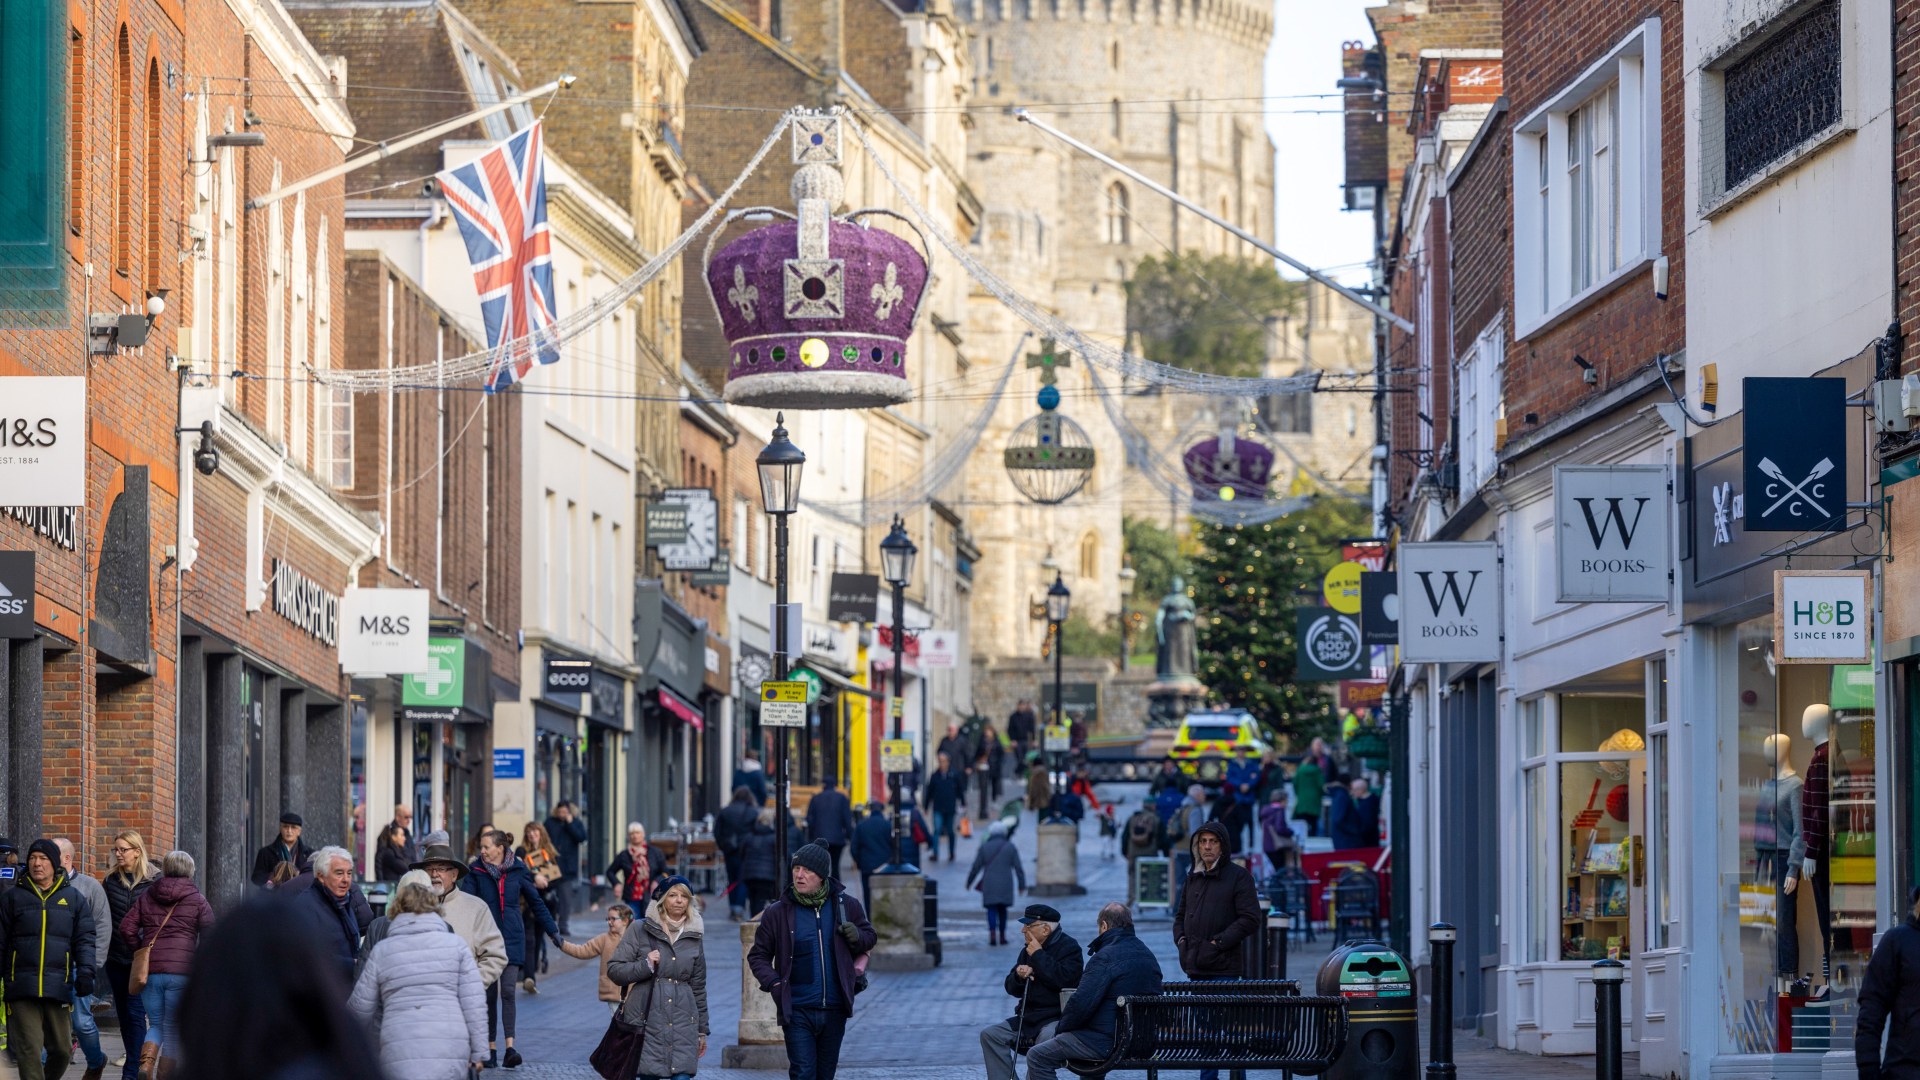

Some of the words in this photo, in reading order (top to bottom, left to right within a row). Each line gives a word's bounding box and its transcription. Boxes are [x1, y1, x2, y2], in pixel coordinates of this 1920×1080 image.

[0, 417, 57, 447] &S
[1573, 497, 1651, 551] W
[1581, 559, 1646, 573] BOOKS
[1413, 570, 1483, 618] W
[1793, 600, 1855, 626] H&B
[359, 615, 410, 635] M&S
[1421, 624, 1479, 638] BOOKS
[1323, 631, 1344, 640] THE
[1793, 632, 1827, 640] SINCE
[1831, 631, 1856, 640] 1870
[1317, 641, 1352, 651] BODY
[1319, 650, 1350, 661] SHOP
